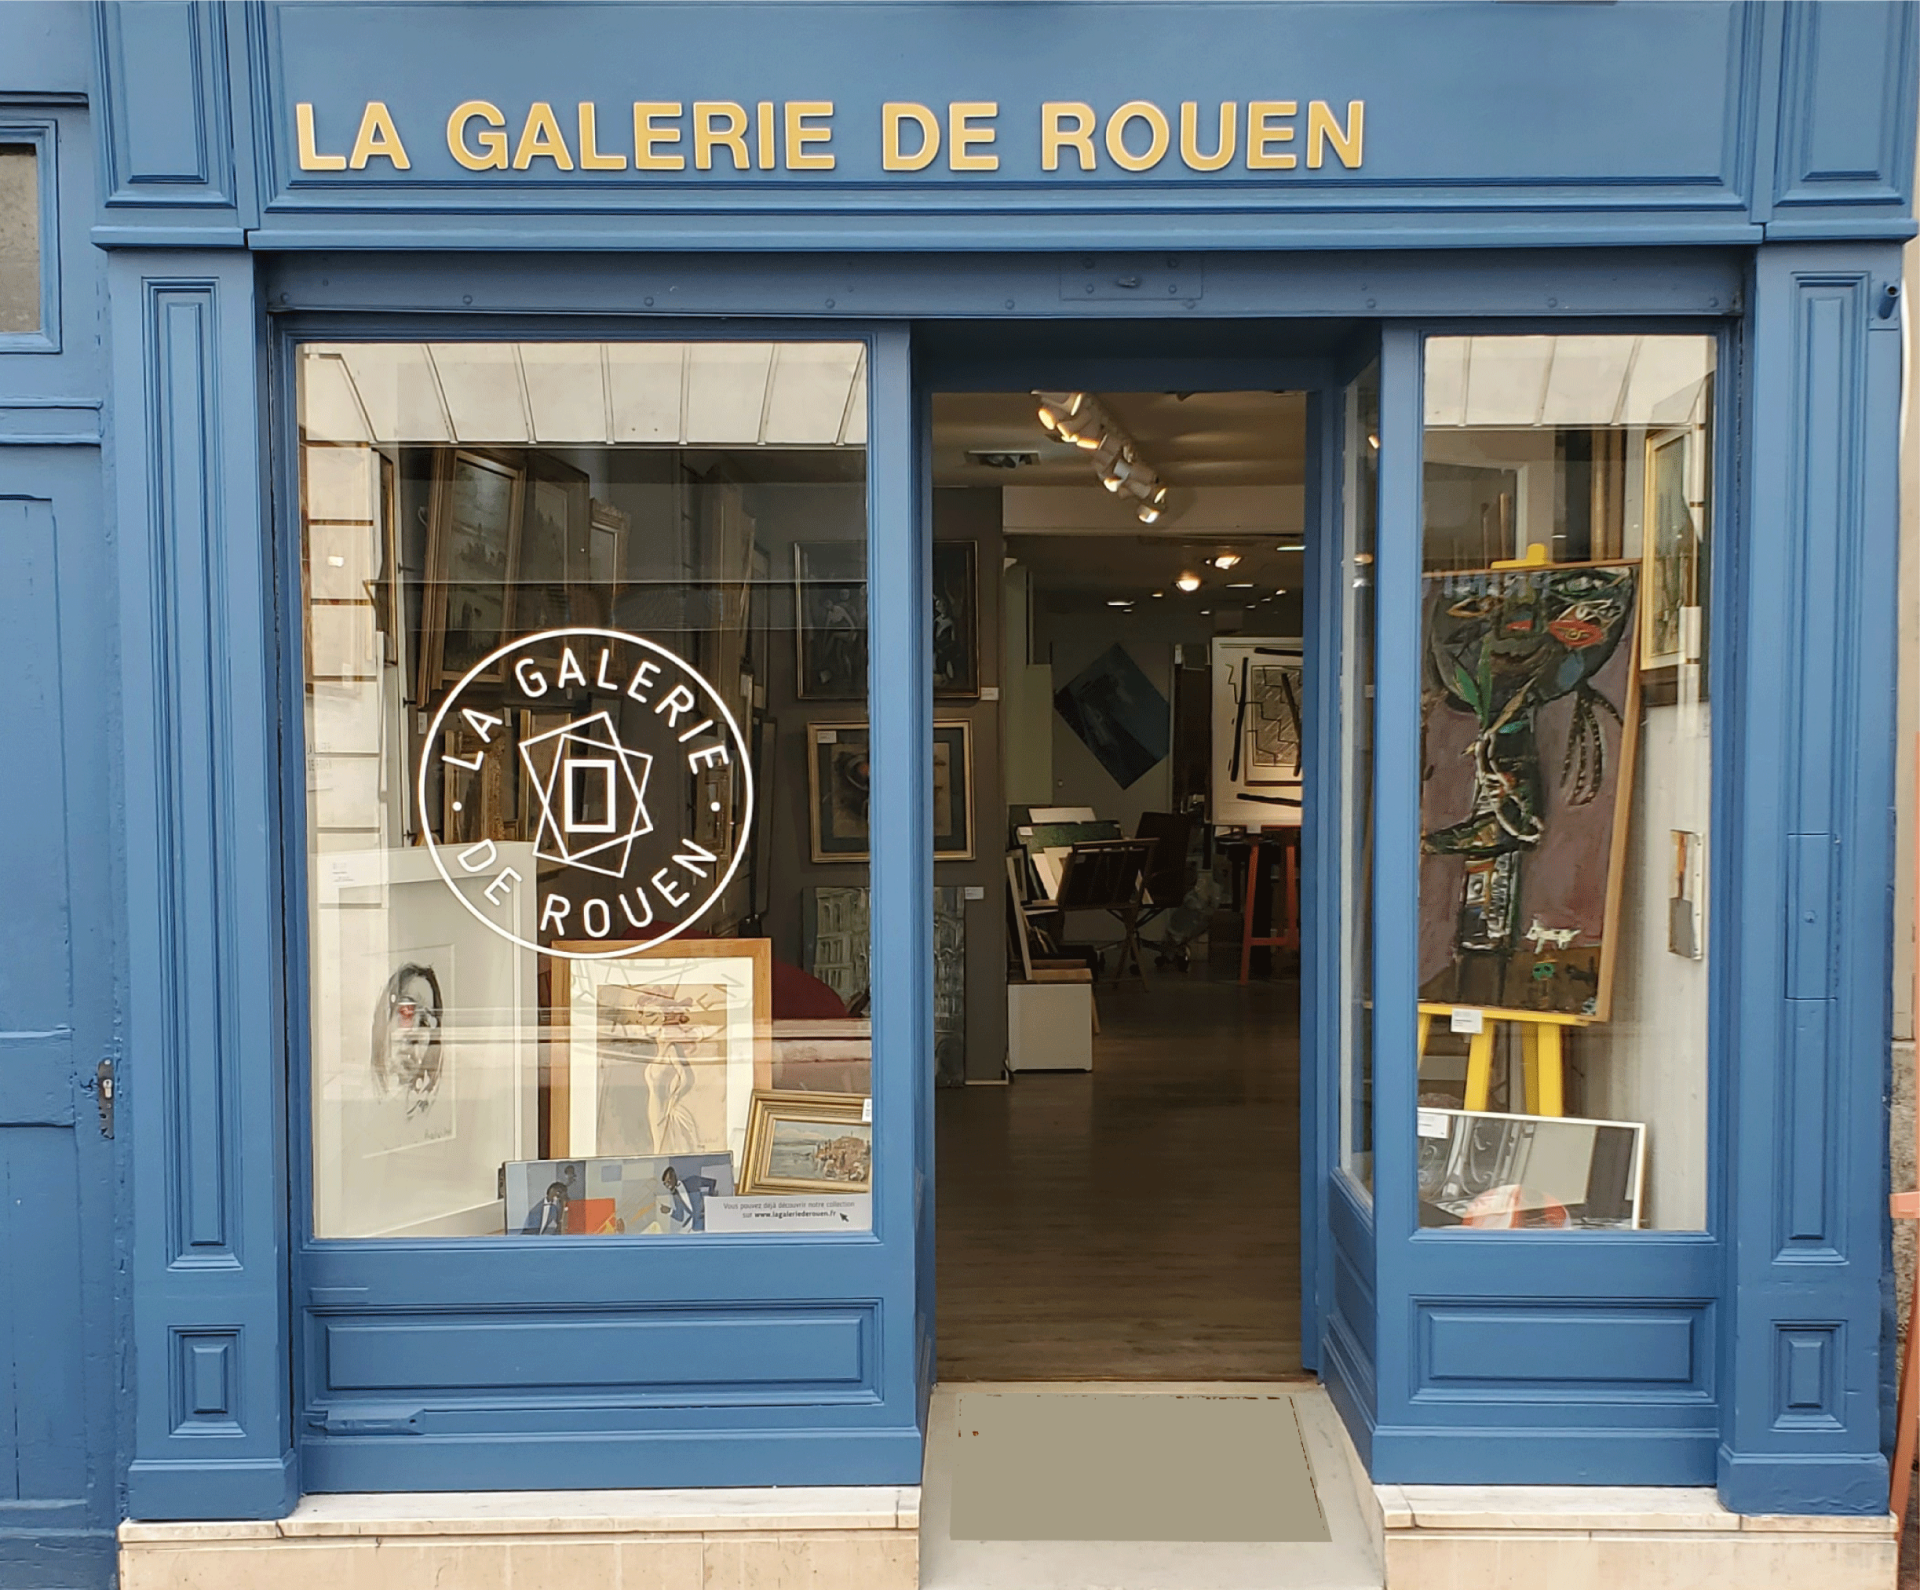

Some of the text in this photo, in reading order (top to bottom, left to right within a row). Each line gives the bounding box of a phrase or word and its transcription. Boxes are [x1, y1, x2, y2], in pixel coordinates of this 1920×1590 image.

[296, 100, 1365, 172] LA GALERIE DE ROUEN
[441, 647, 730, 775] LA GALERIE
[457, 838, 717, 938] DE ROUEN
[723, 1202, 739, 1210] Vous
[754, 1210, 836, 1219] www.lagaleriederouen.fr
